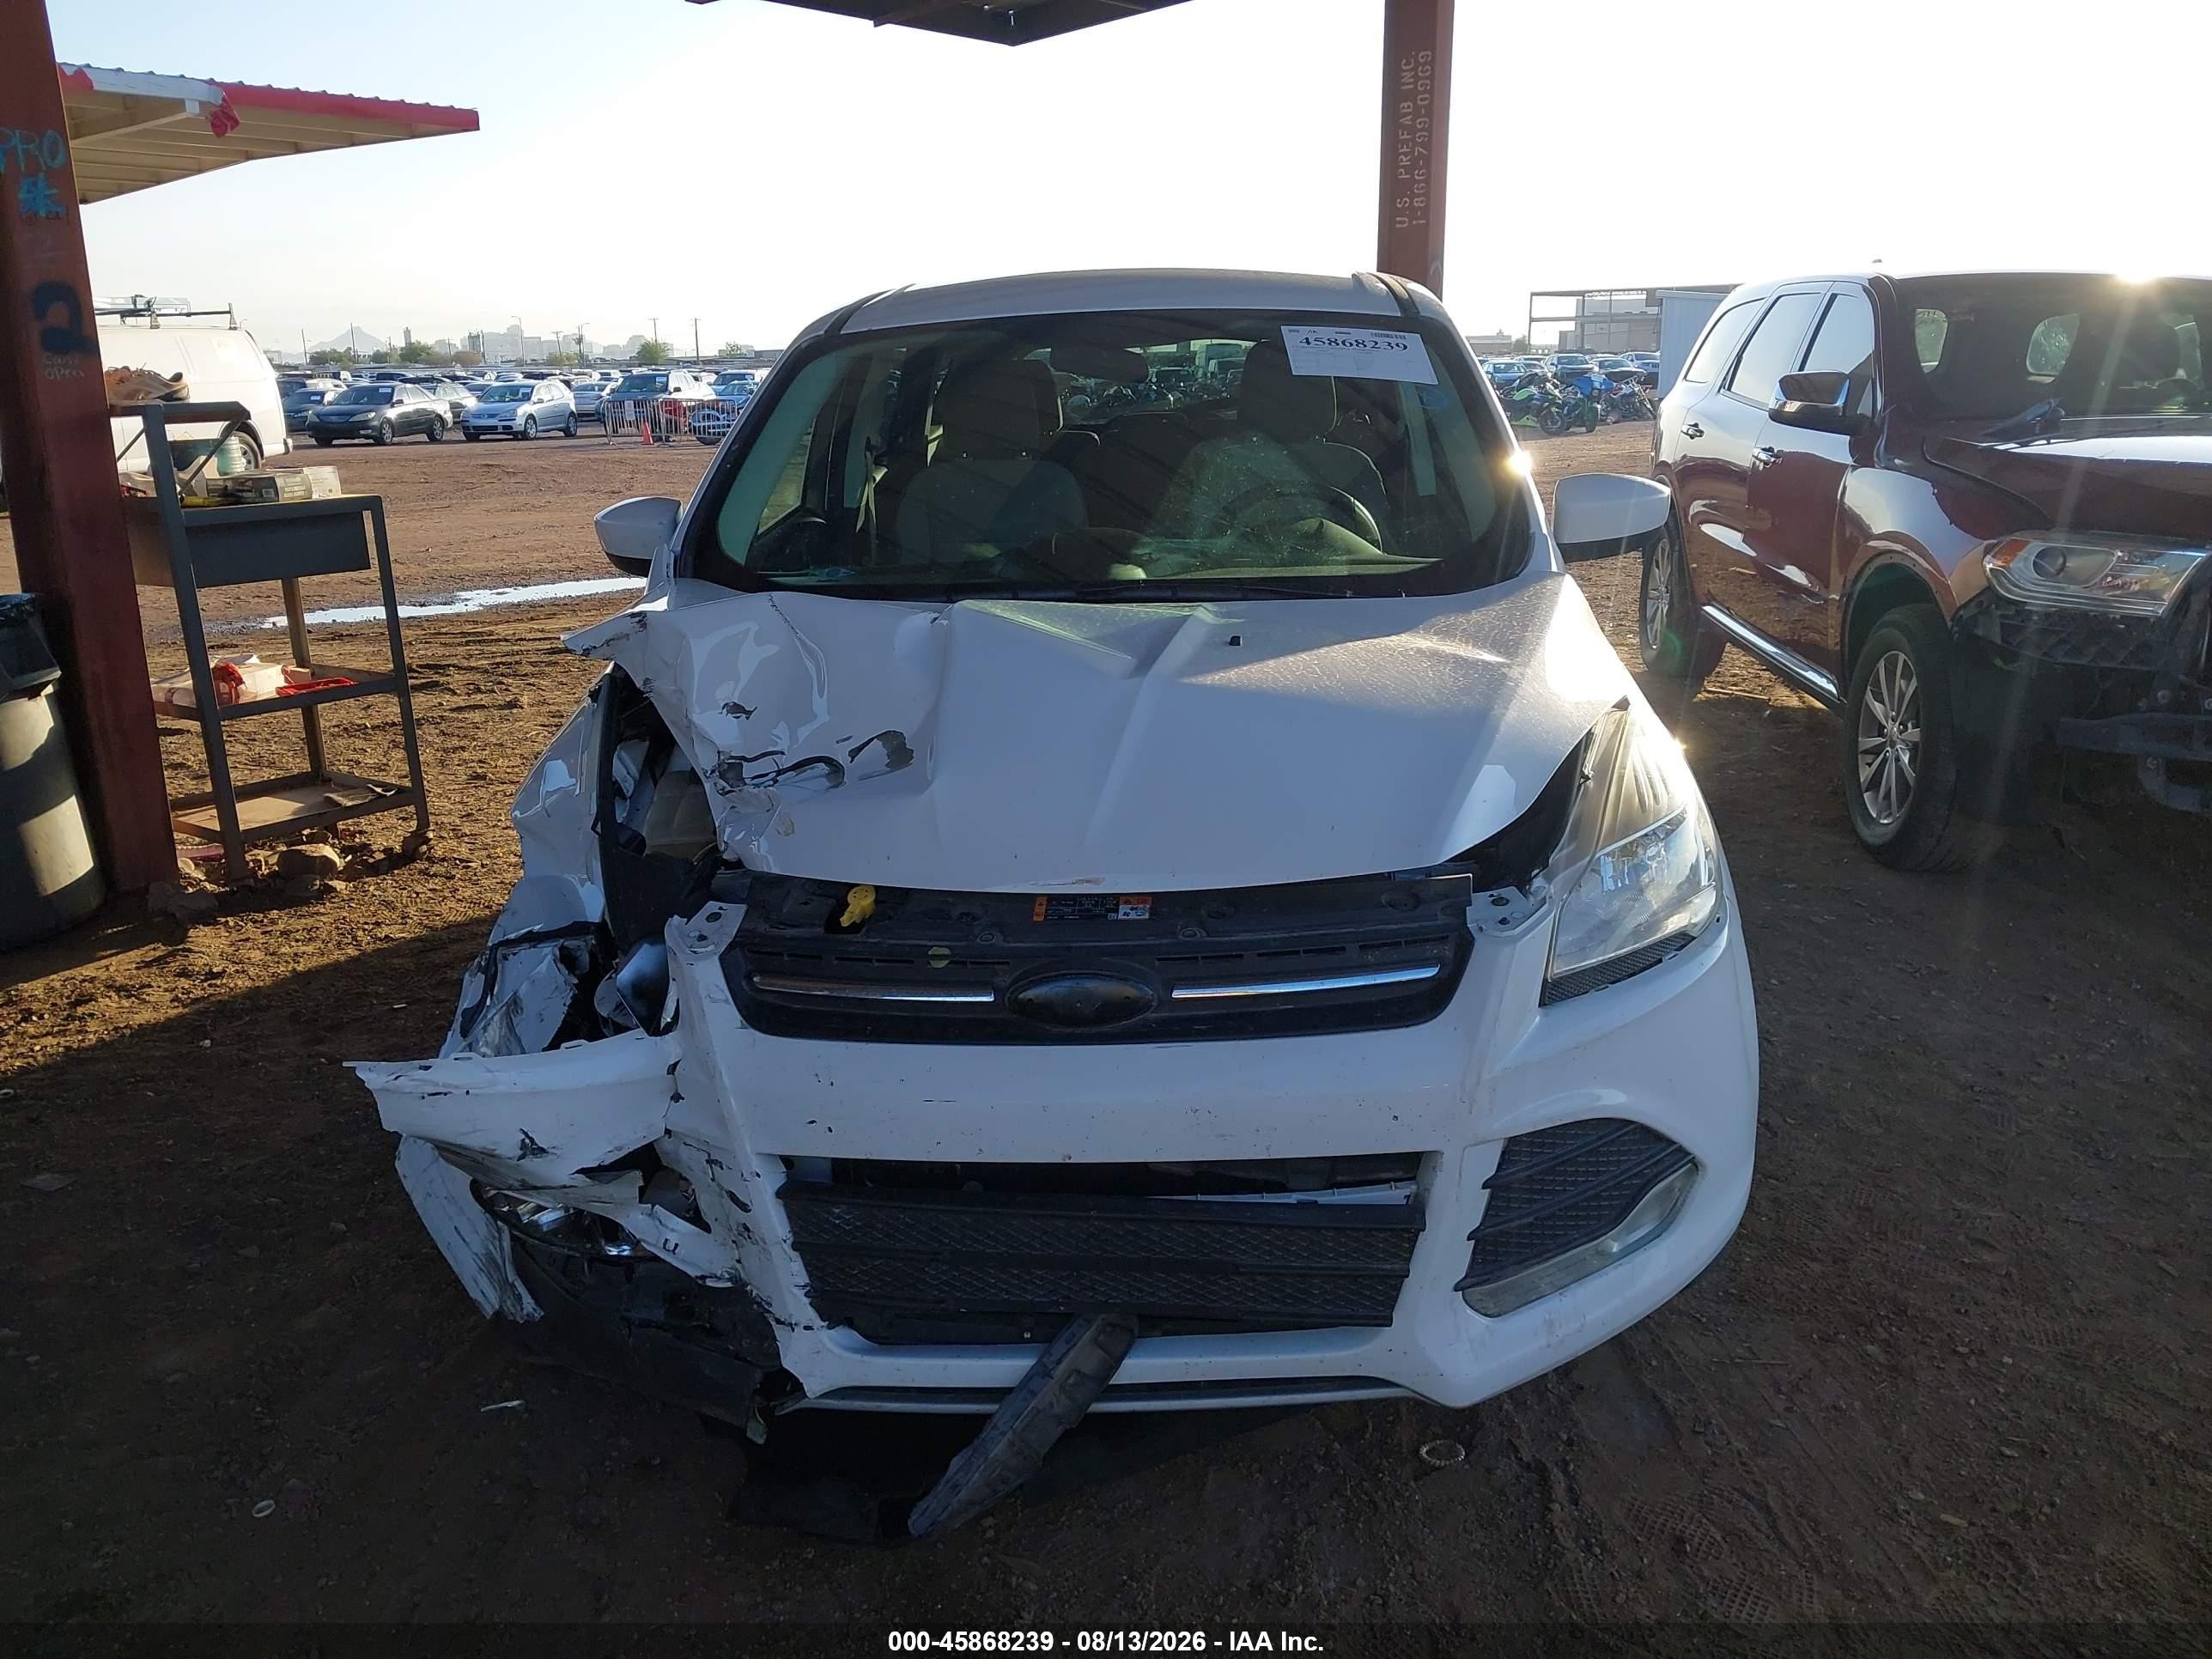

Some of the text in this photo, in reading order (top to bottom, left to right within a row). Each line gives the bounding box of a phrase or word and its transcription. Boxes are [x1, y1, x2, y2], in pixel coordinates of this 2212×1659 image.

[1396, 51, 1416, 228] U.S. PREFAB INC.
[1413, 51, 1432, 225] 1-866-799-0969
[1298, 336, 1408, 351] 45868239
